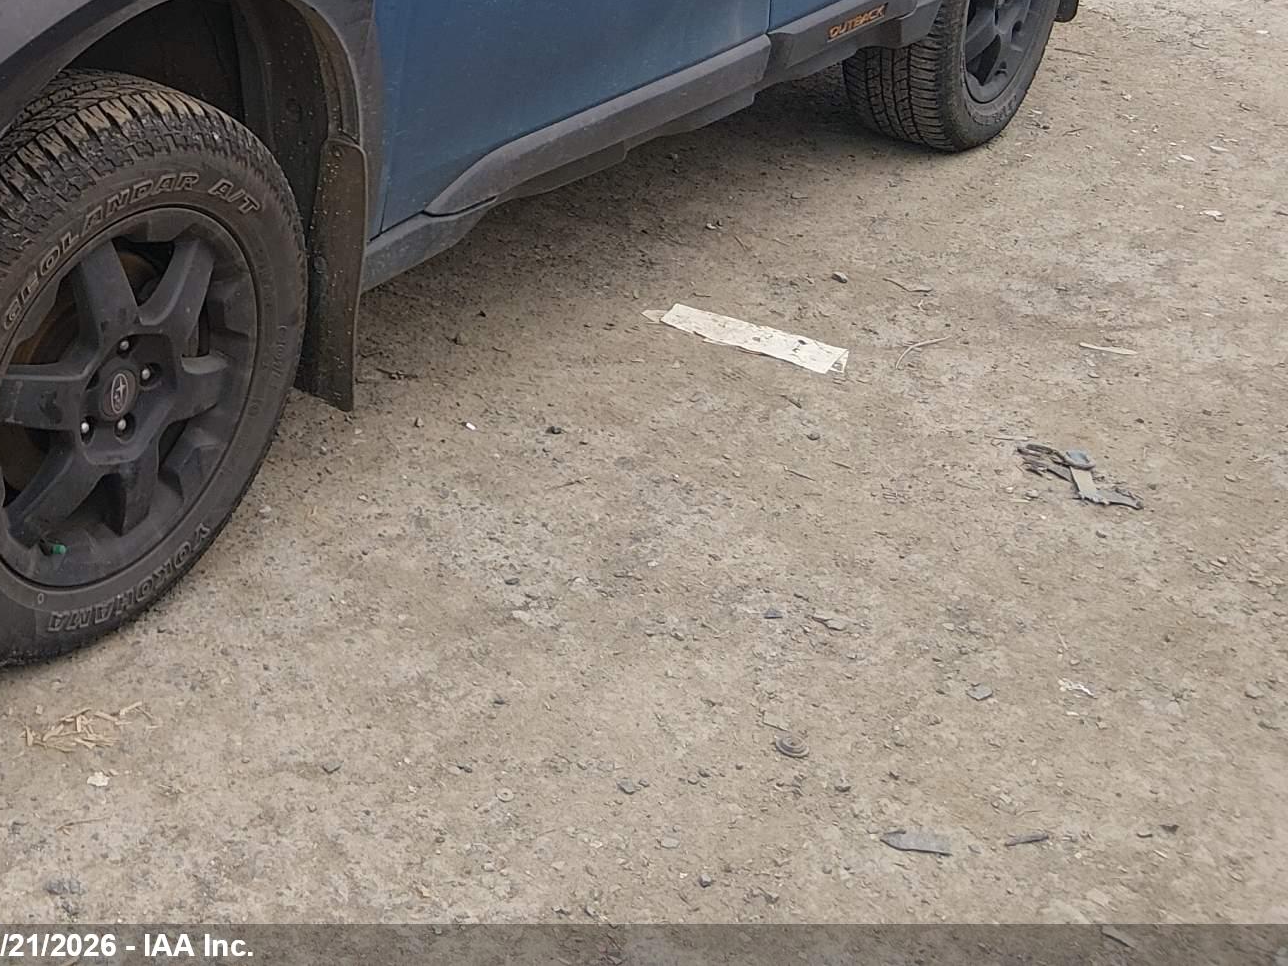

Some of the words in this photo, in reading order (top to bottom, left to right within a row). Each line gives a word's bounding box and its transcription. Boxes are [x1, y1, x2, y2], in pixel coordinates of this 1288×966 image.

[829, 4, 886, 38] OUTBACK
[3, 171, 200, 330] GEOLANDAR
[207, 177, 261, 216] A/T
[47, 522, 211, 632] YOKOHAMA
